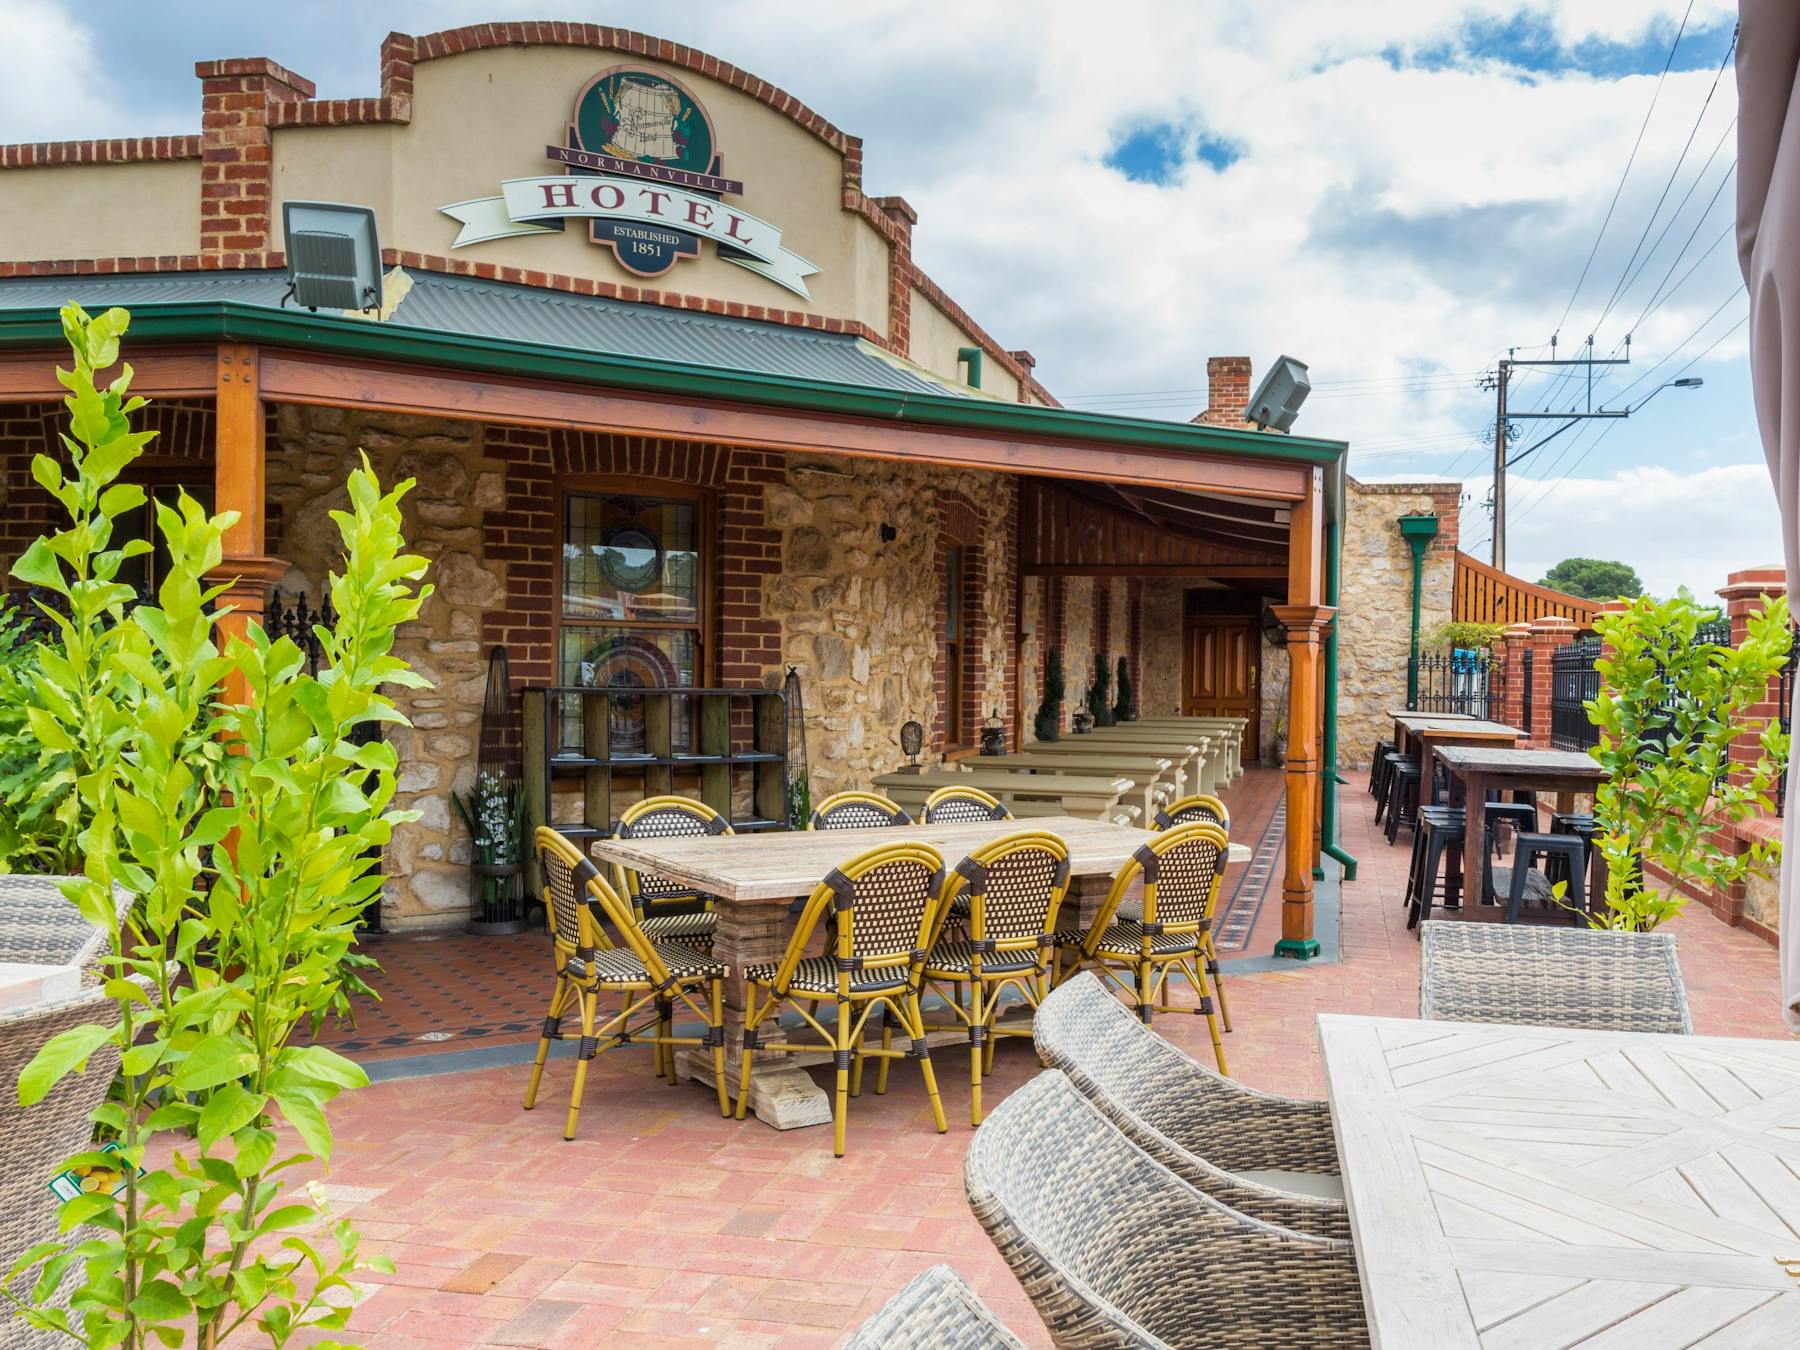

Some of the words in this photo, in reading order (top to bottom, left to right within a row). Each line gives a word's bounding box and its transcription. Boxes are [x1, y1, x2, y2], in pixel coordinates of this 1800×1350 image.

[640, 132, 657, 142] Hotel
[559, 150, 734, 192] NORMANVILLE
[538, 184, 753, 245] HOTEL
[613, 226, 680, 245] ESTABLISHED
[631, 241, 661, 257] 1851
